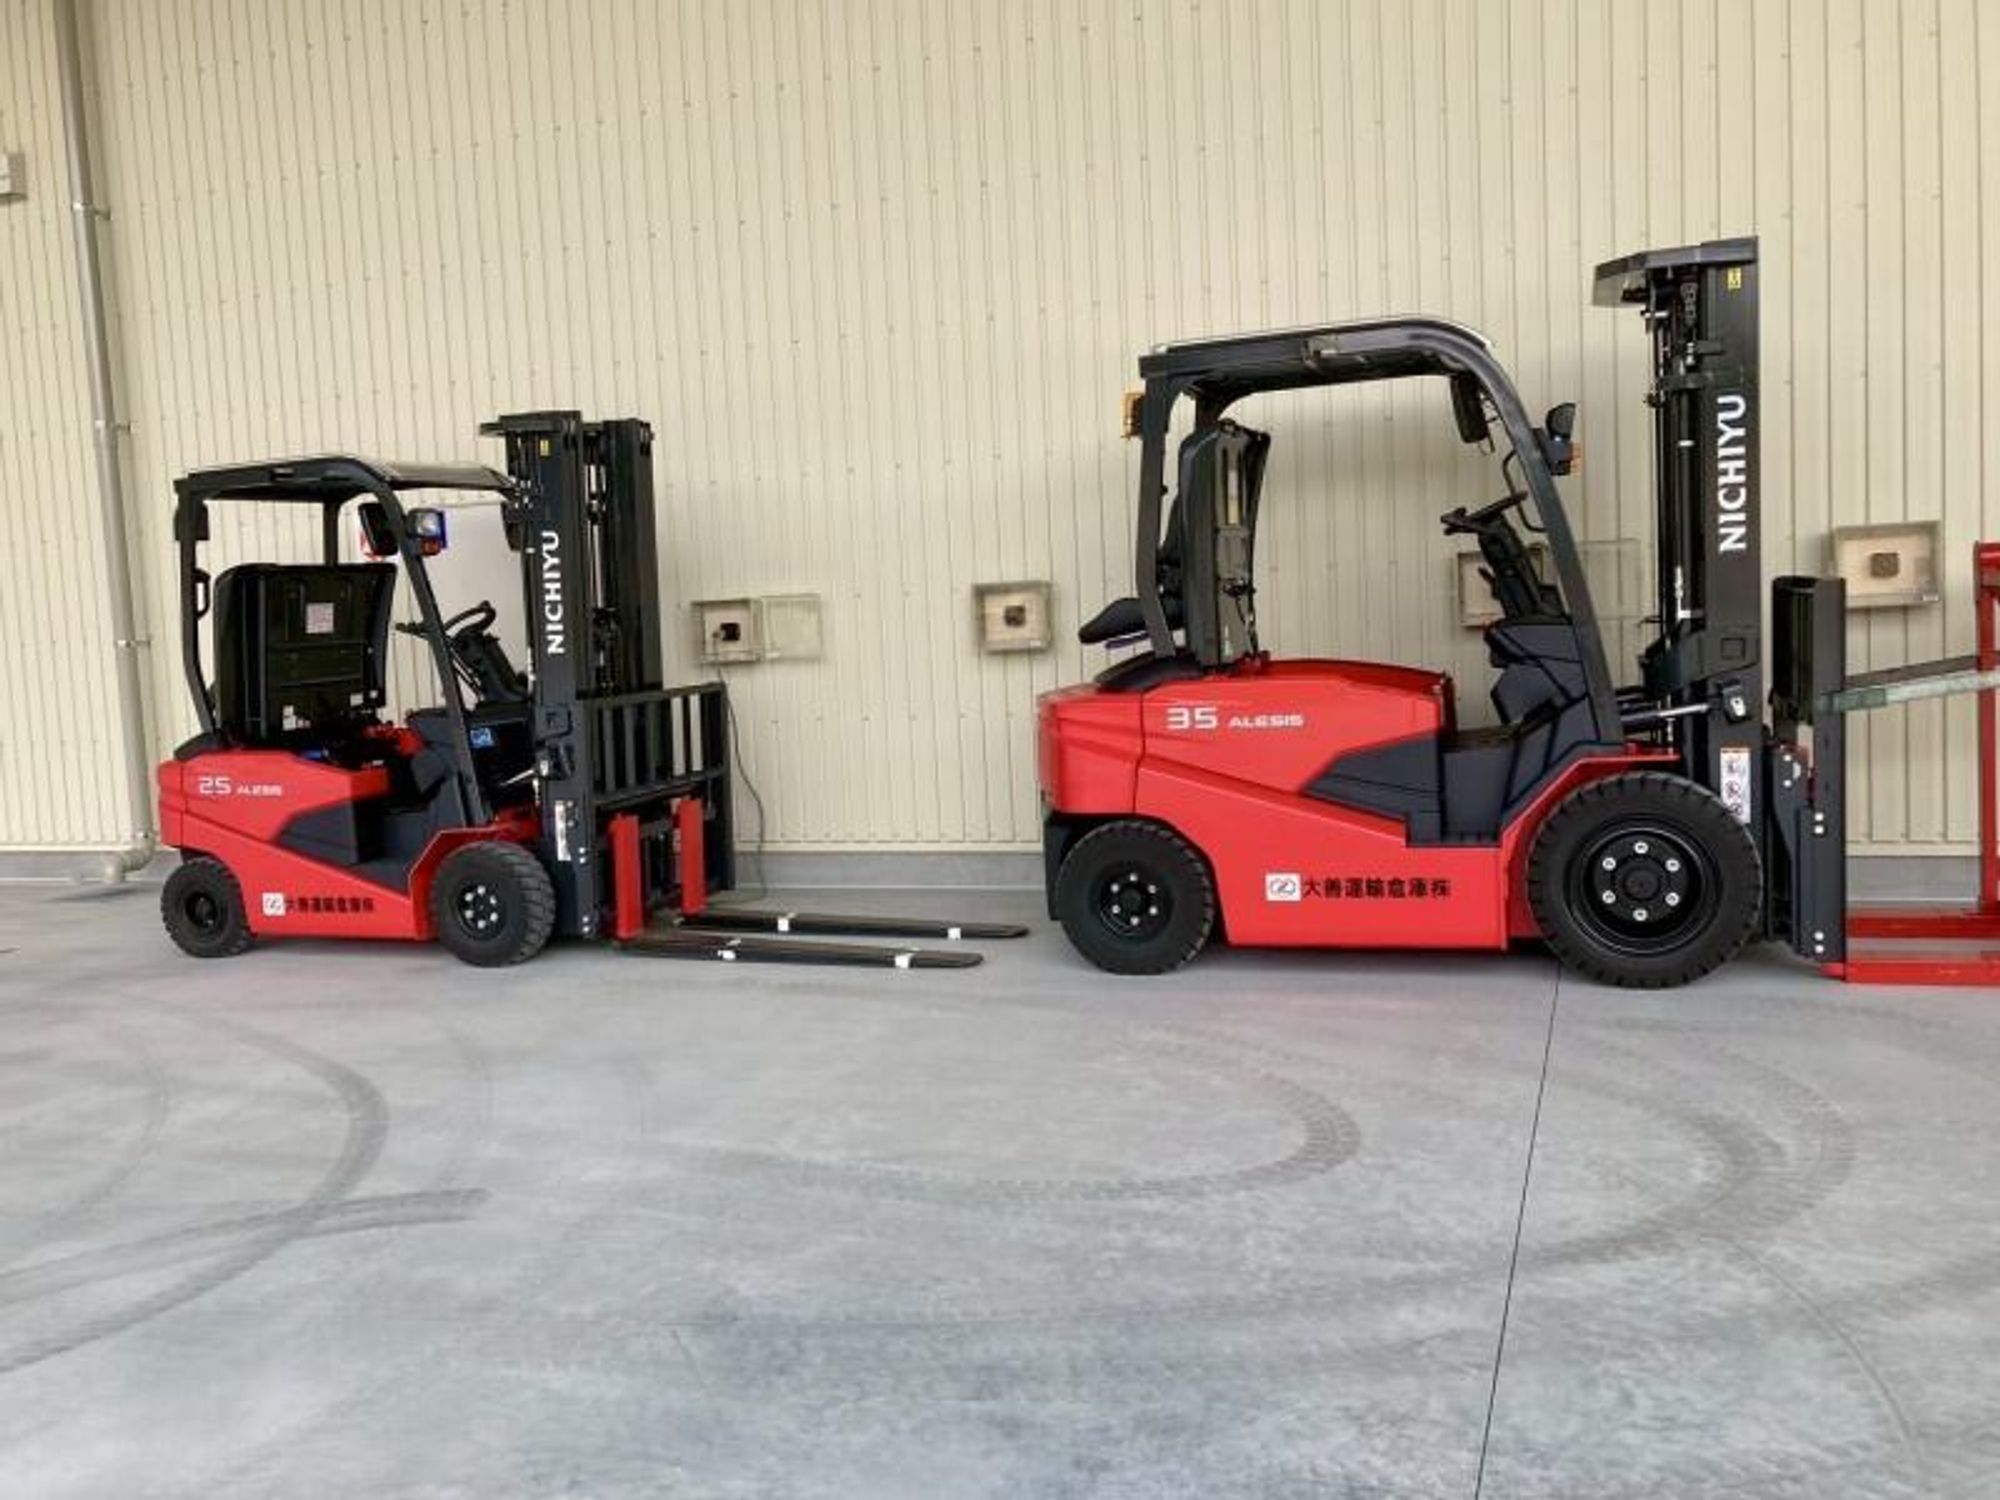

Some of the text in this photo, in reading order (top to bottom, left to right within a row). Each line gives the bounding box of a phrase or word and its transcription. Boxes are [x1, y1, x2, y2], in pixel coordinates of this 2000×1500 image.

[1717, 394, 1747, 554] NICHIYU
[541, 530, 566, 655] NICHIYU
[1167, 707, 1304, 729] 35 ALESIS
[199, 776, 231, 794] 25
